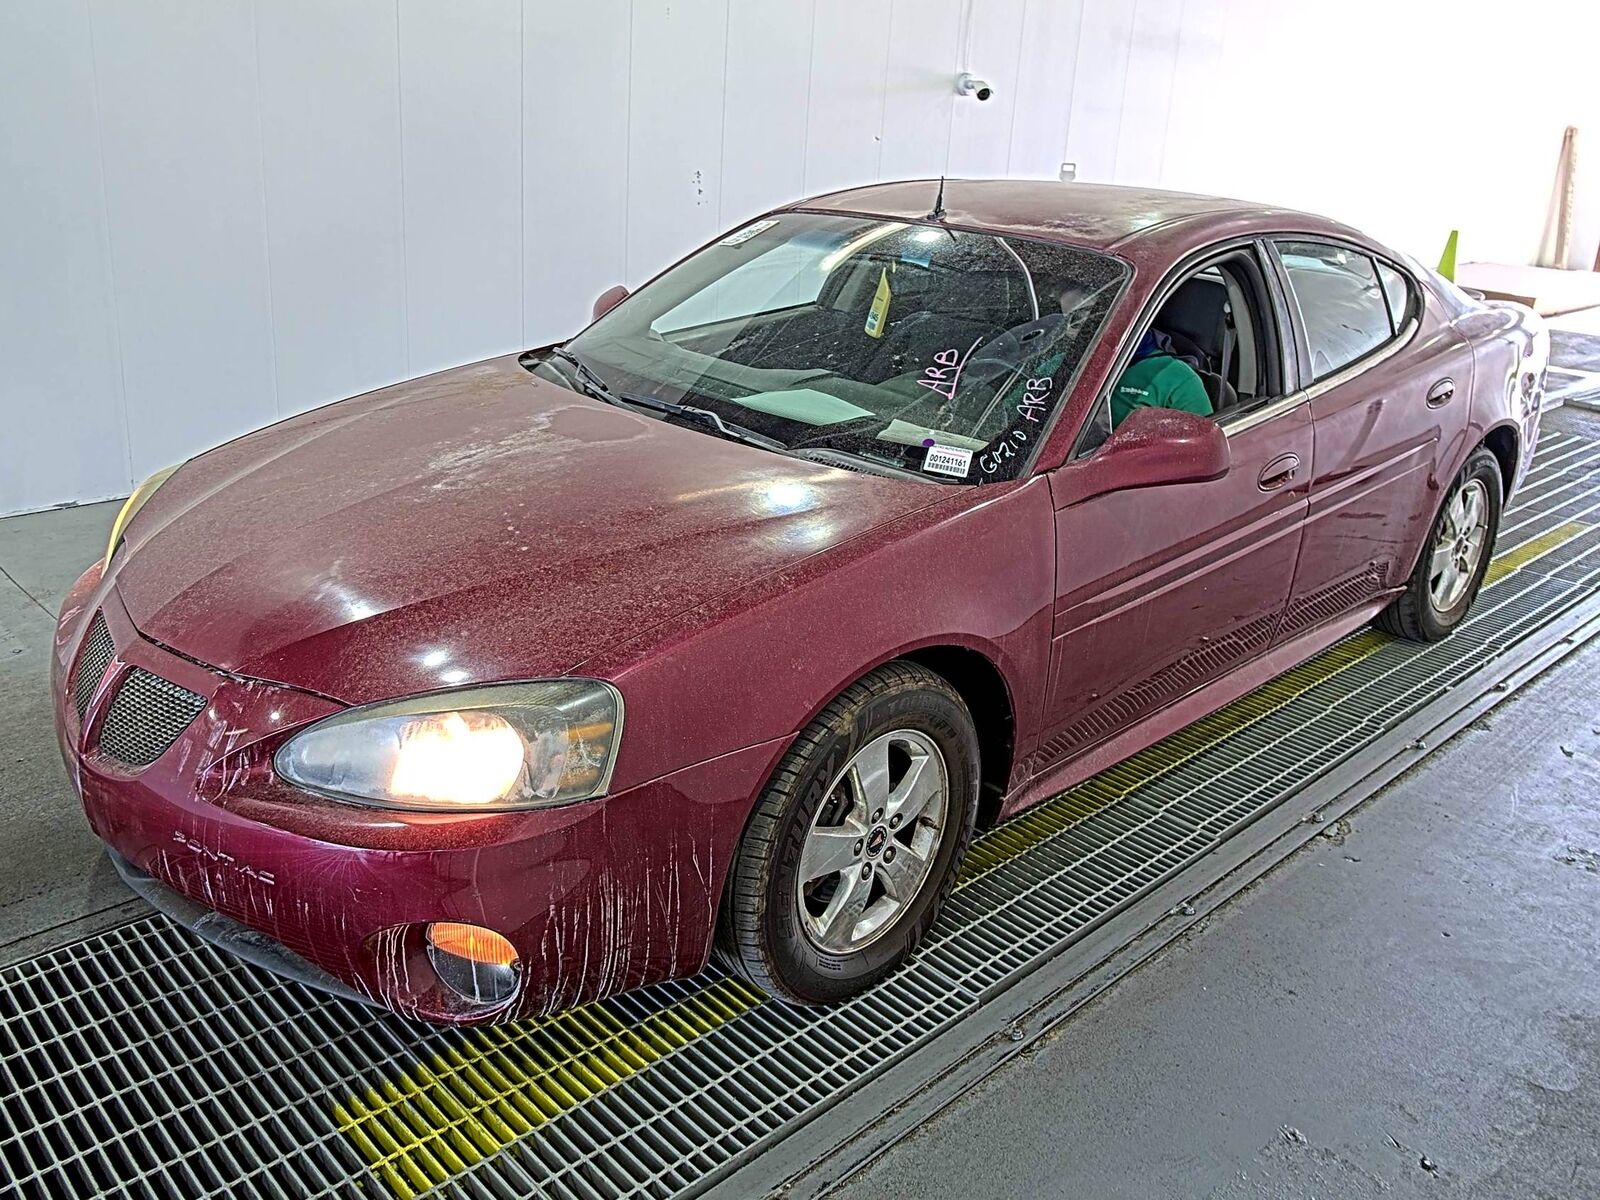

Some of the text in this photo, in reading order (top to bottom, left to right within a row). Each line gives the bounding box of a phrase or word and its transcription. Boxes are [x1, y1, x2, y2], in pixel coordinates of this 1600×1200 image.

[916, 349, 960, 399] ARB
[1016, 377, 1053, 422] ARB
[929, 454, 967, 468] 001241161
